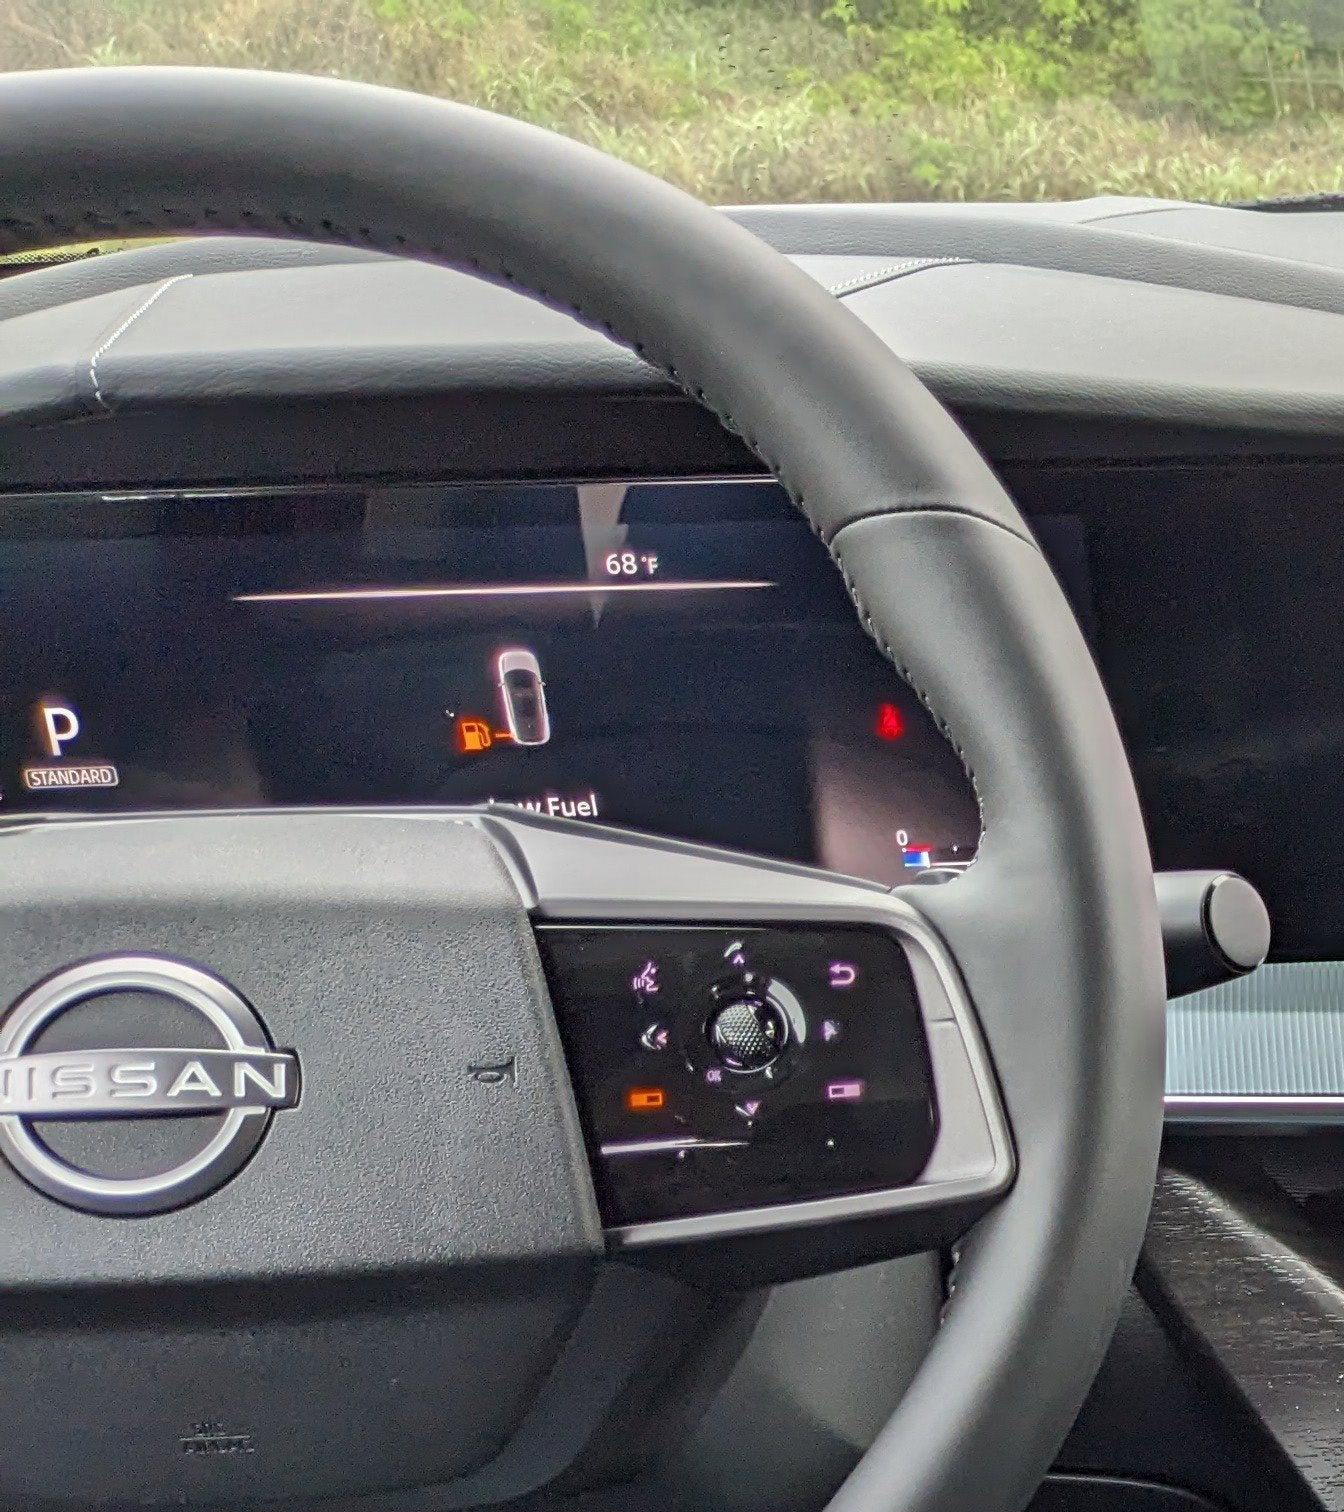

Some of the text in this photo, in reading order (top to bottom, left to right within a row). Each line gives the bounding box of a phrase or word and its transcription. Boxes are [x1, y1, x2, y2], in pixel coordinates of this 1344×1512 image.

[605, 553, 637, 576] 68
[43, 707, 79, 756] P
[31, 769, 112, 786] STANDARD
[547, 794, 598, 817] Fuel
[0, 1060, 287, 1102] ISSAN
